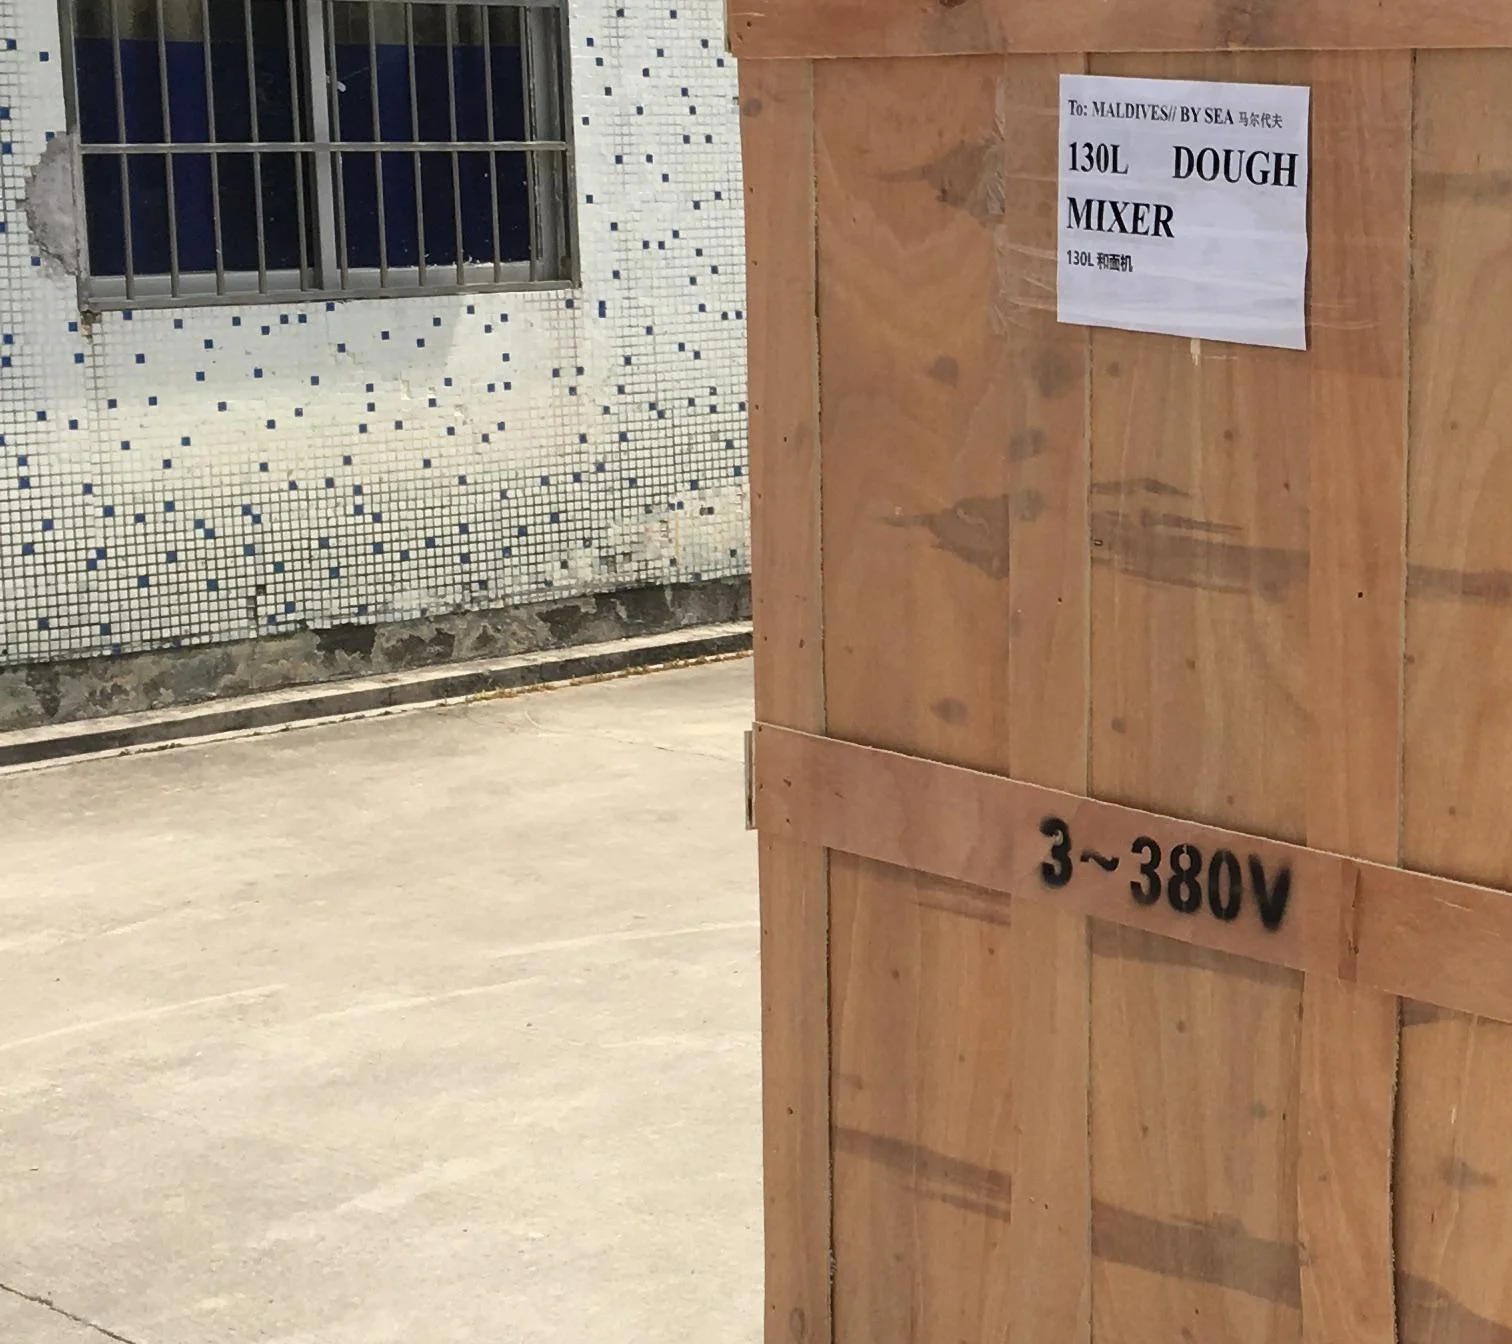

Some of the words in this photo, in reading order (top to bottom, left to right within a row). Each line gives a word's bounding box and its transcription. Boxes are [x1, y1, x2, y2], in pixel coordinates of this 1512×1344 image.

[1067, 99, 1088, 116] To:
[1180, 106, 1201, 123] BY
[1204, 107, 1234, 125] SEA
[1238, 111, 1283, 129] 马尔代夫
[1068, 141, 1128, 175] 130L
[1172, 145, 1299, 187] DOUGH
[1066, 196, 1175, 238] MIXER
[1066, 249, 1095, 267] 130L
[1096, 252, 1133, 272] 和面机
